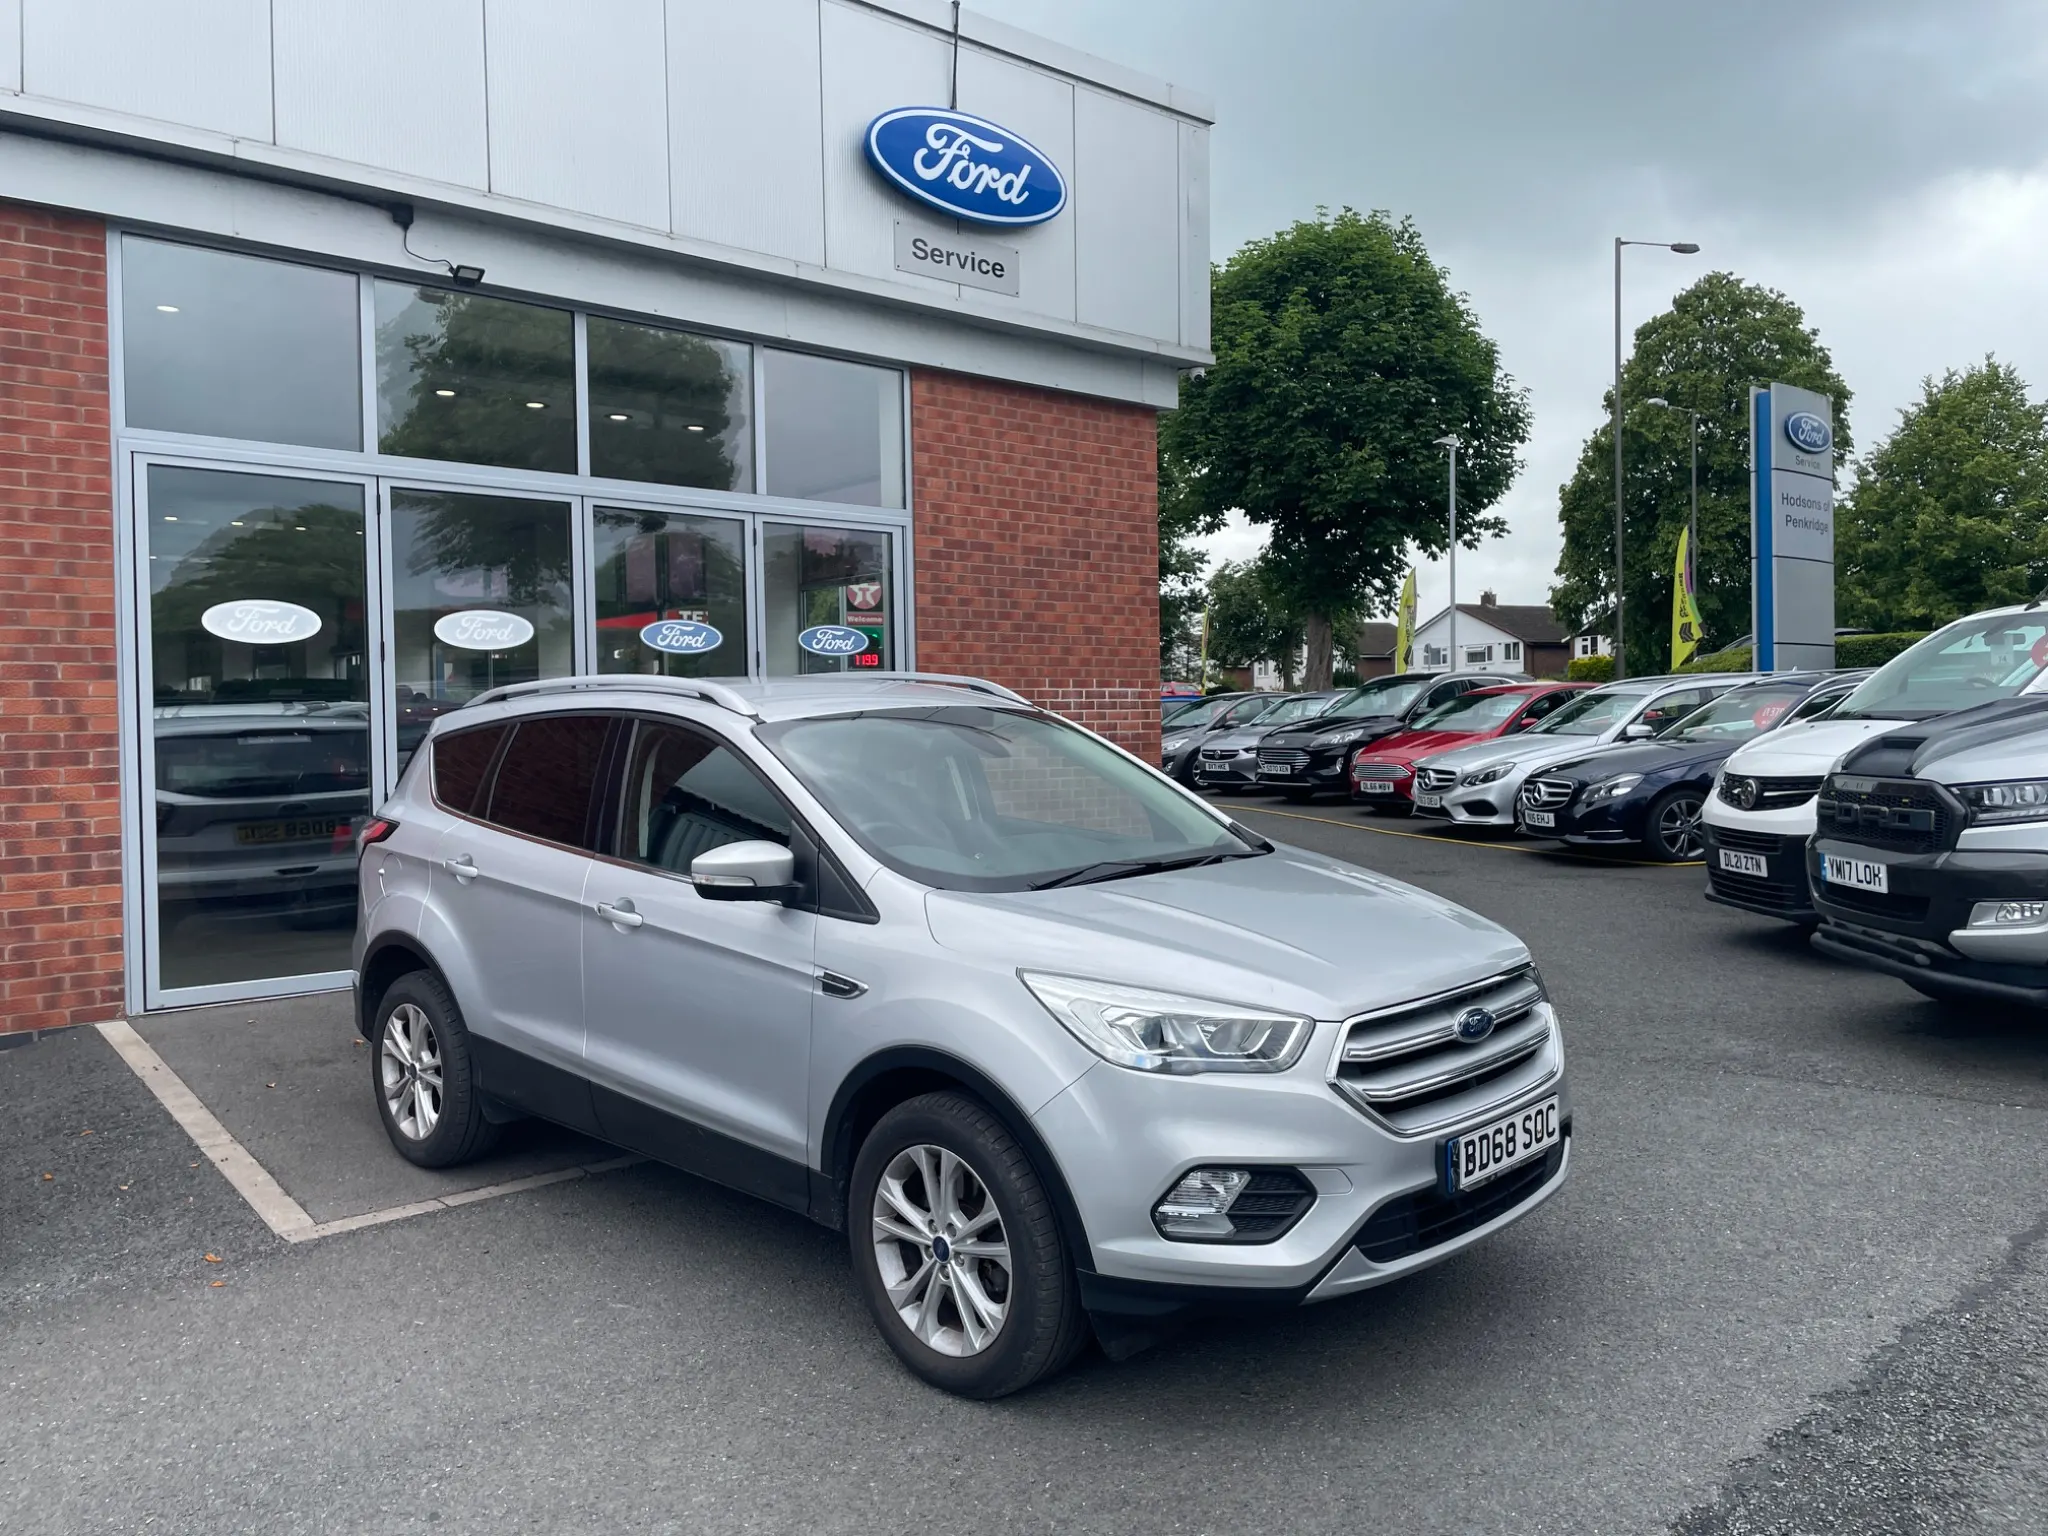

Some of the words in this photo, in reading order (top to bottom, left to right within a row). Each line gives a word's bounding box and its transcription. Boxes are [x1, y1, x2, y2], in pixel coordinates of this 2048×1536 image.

[912, 122, 1032, 205] Ford
[911, 237, 1006, 279] Service
[1798, 417, 1825, 446] Ford
[1795, 455, 1821, 470] Service
[1781, 492, 1821, 511] Hodsons
[1785, 514, 1829, 536] Penkridge
[227, 604, 297, 635] Ford
[455, 615, 513, 642] Ford
[847, 615, 883, 623] Welcome
[656, 623, 707, 648] Ford
[812, 630, 855, 651] Ford
[1723, 852, 1742, 869] DL21
[1744, 855, 1762, 873] ZTN
[1828, 857, 1852, 881] YM17
[1464, 1120, 1517, 1179] BD68
[1522, 1103, 1557, 1151] SOC
